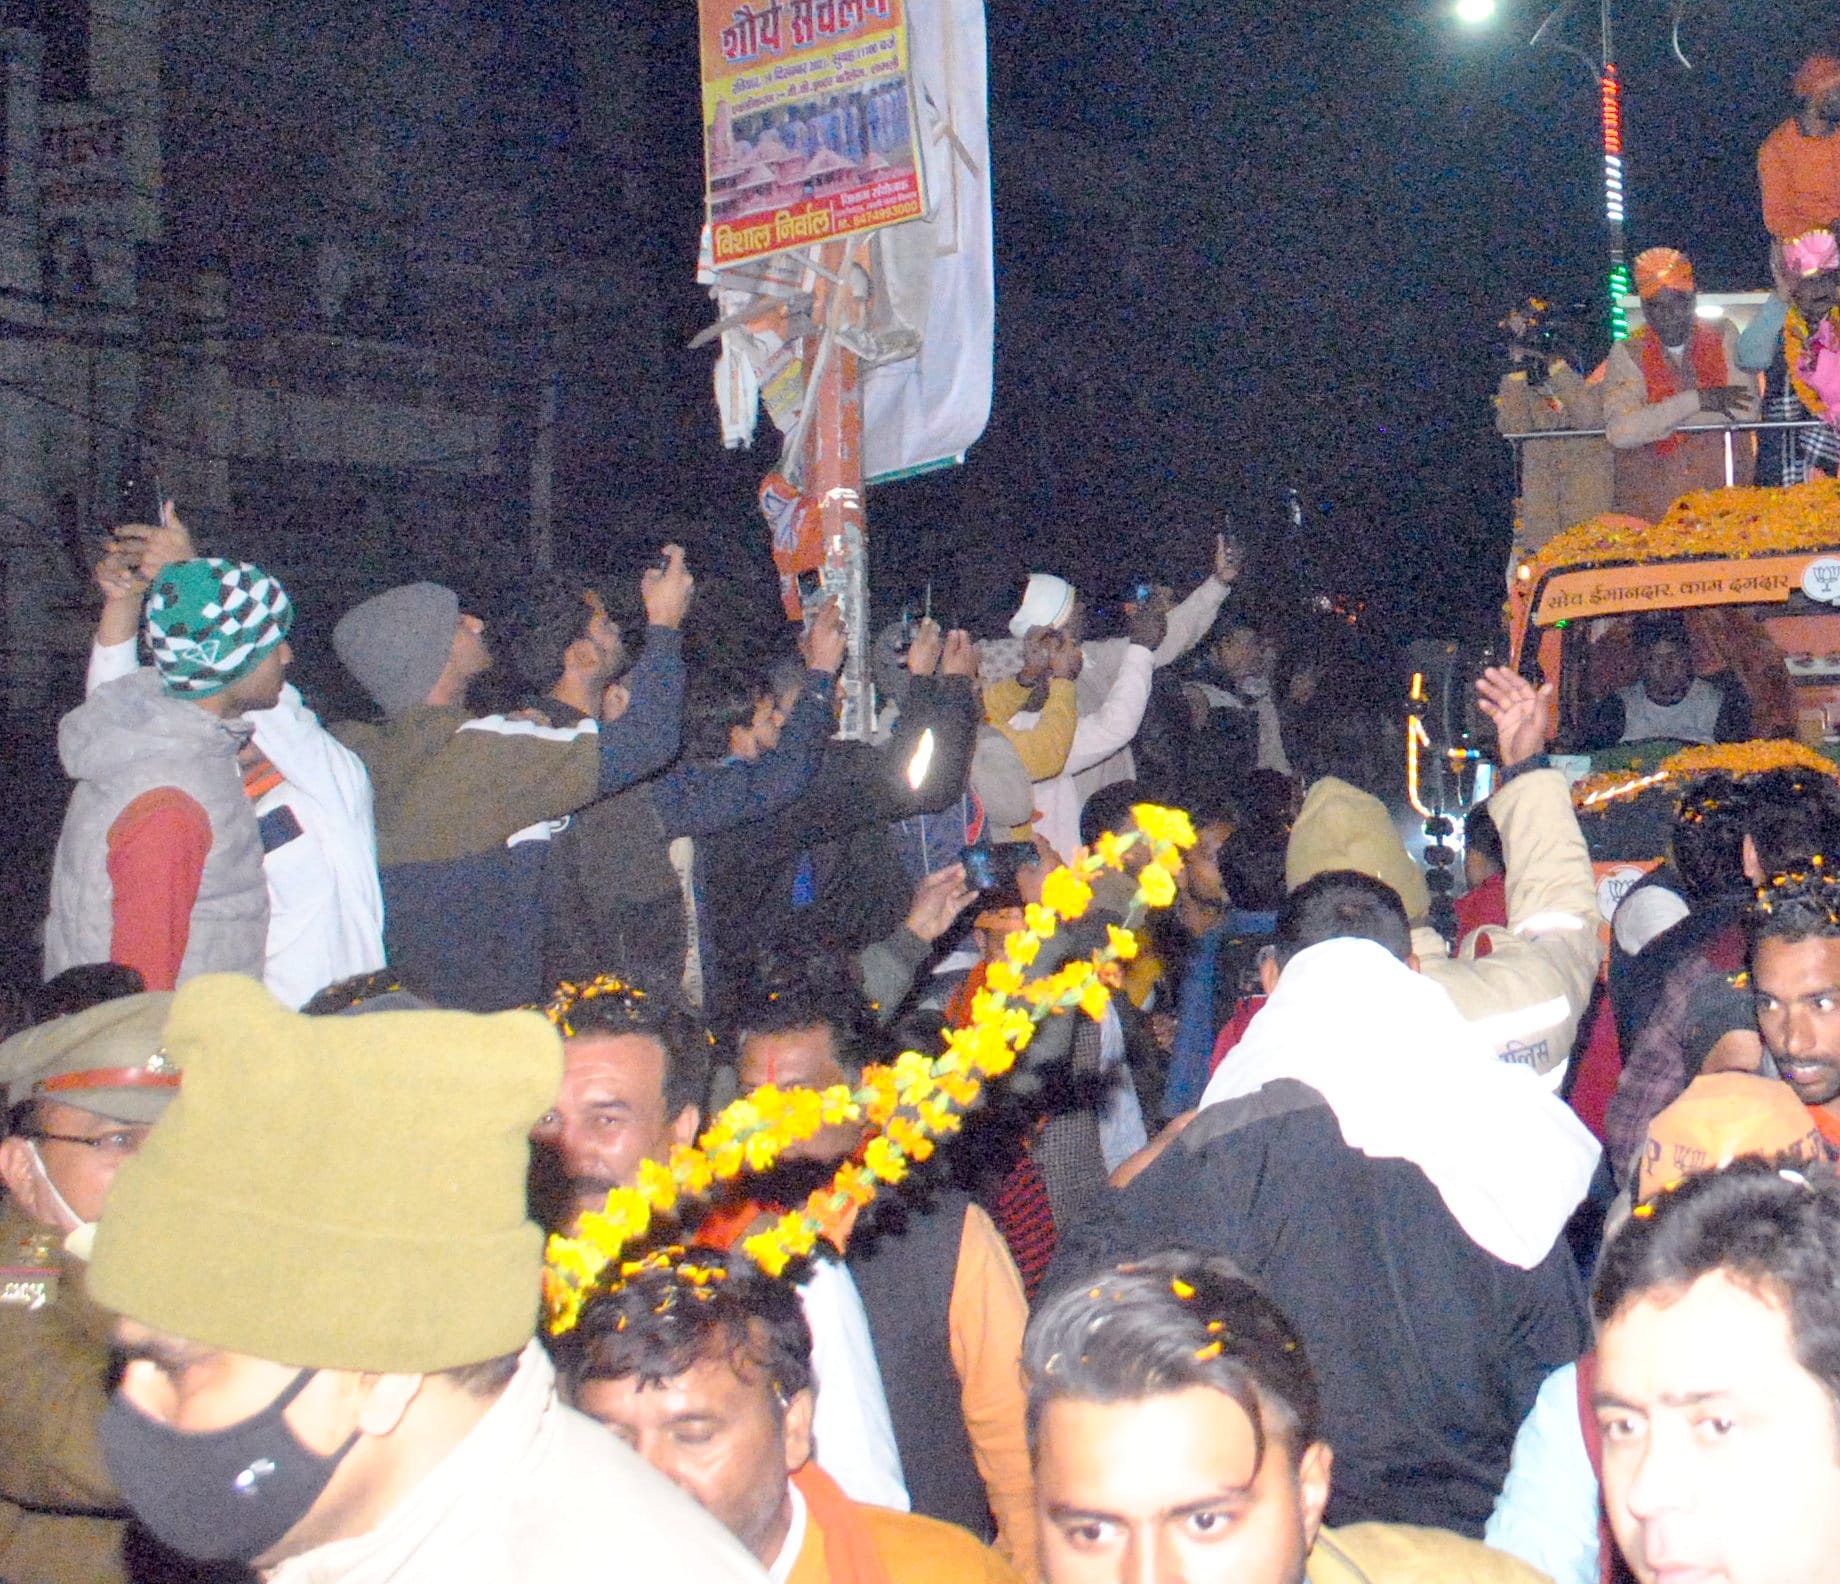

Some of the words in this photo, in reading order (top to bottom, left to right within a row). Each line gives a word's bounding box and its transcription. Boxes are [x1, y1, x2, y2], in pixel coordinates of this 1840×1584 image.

[716, 221, 772, 257] विशाल
[1680, 579, 1723, 595] काम
[1730, 574, 1790, 592] दमदार
